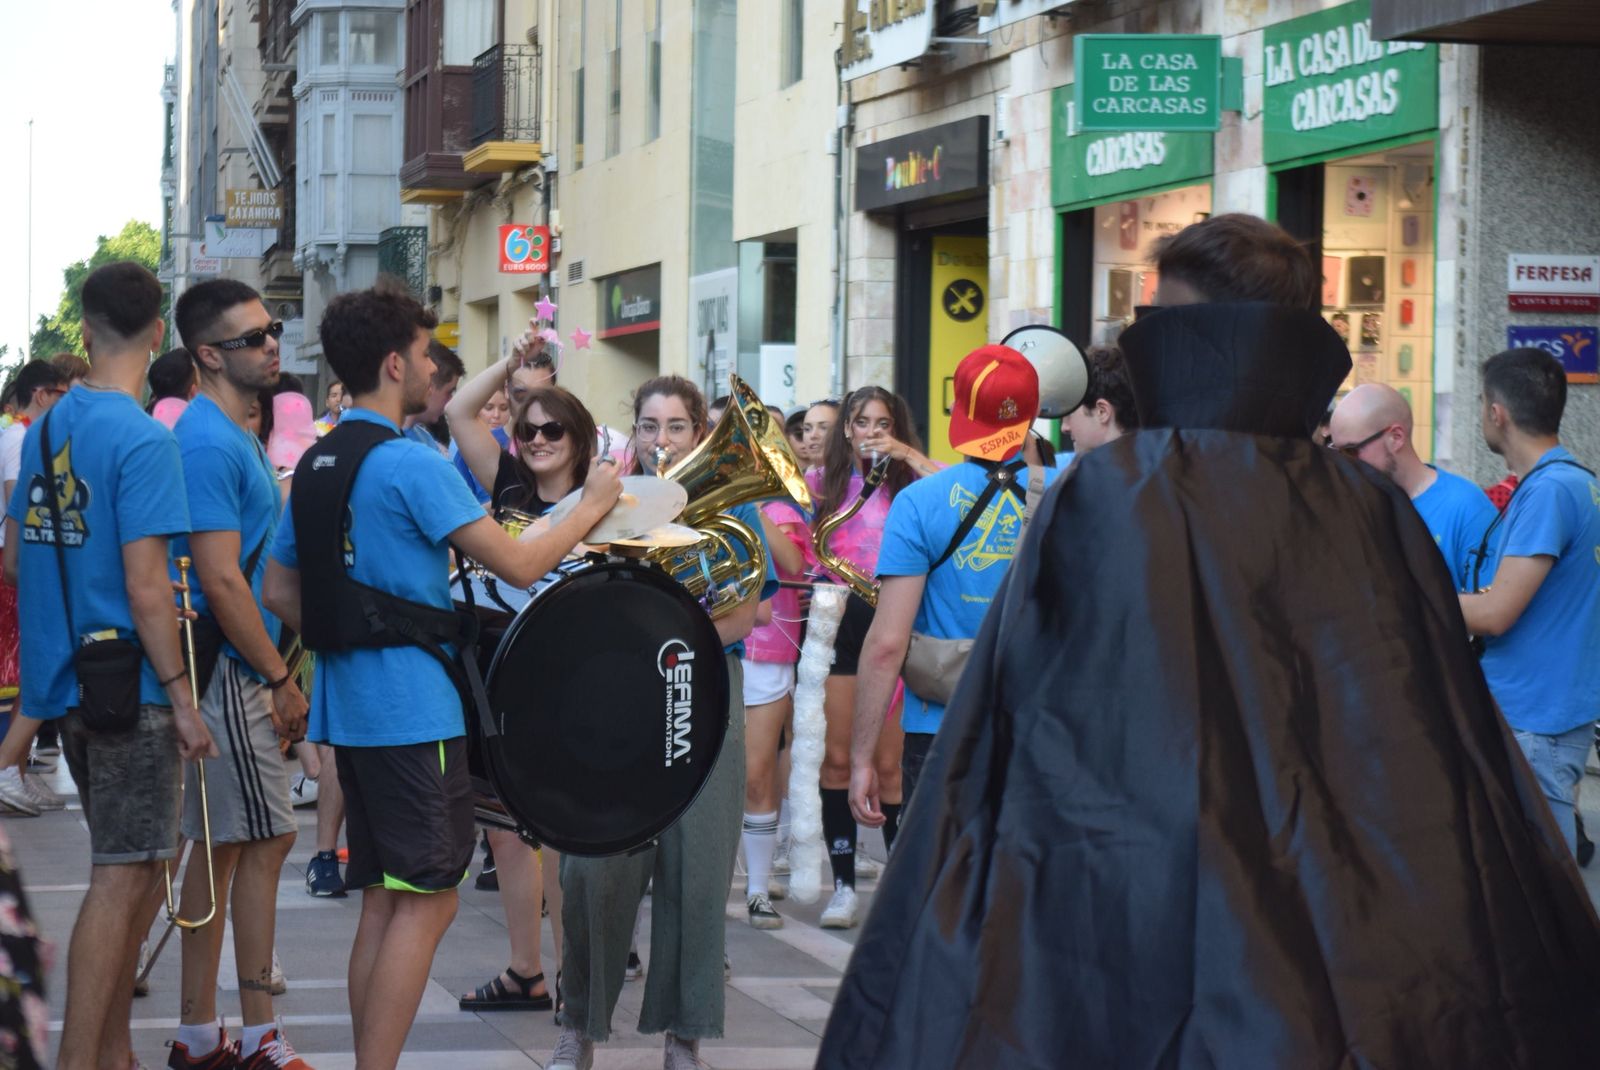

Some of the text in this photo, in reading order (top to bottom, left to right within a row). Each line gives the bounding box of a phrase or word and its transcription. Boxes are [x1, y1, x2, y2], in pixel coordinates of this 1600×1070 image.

[1102, 53, 1199, 71] LA CASA
[1265, 42, 1295, 87] LA
[1298, 26, 1353, 77] CASA
[1109, 75, 1190, 92] DE LAS
[1093, 97, 1208, 114] CARCASAS
[1291, 68, 1400, 131] CARCASAS
[1086, 132, 1166, 176] CARCASAS
[234, 191, 276, 205] TEJIDOS
[228, 206, 281, 220] CAXANDRA
[503, 263, 547, 271] EURO 6000
[1516, 265, 1592, 282] FERFESA
[980, 431, 1021, 455] ESPAÑA
[24, 527, 40, 541] EL
[666, 650, 695, 760] LEFIMA
[664, 684, 673, 758] INNOVATION
